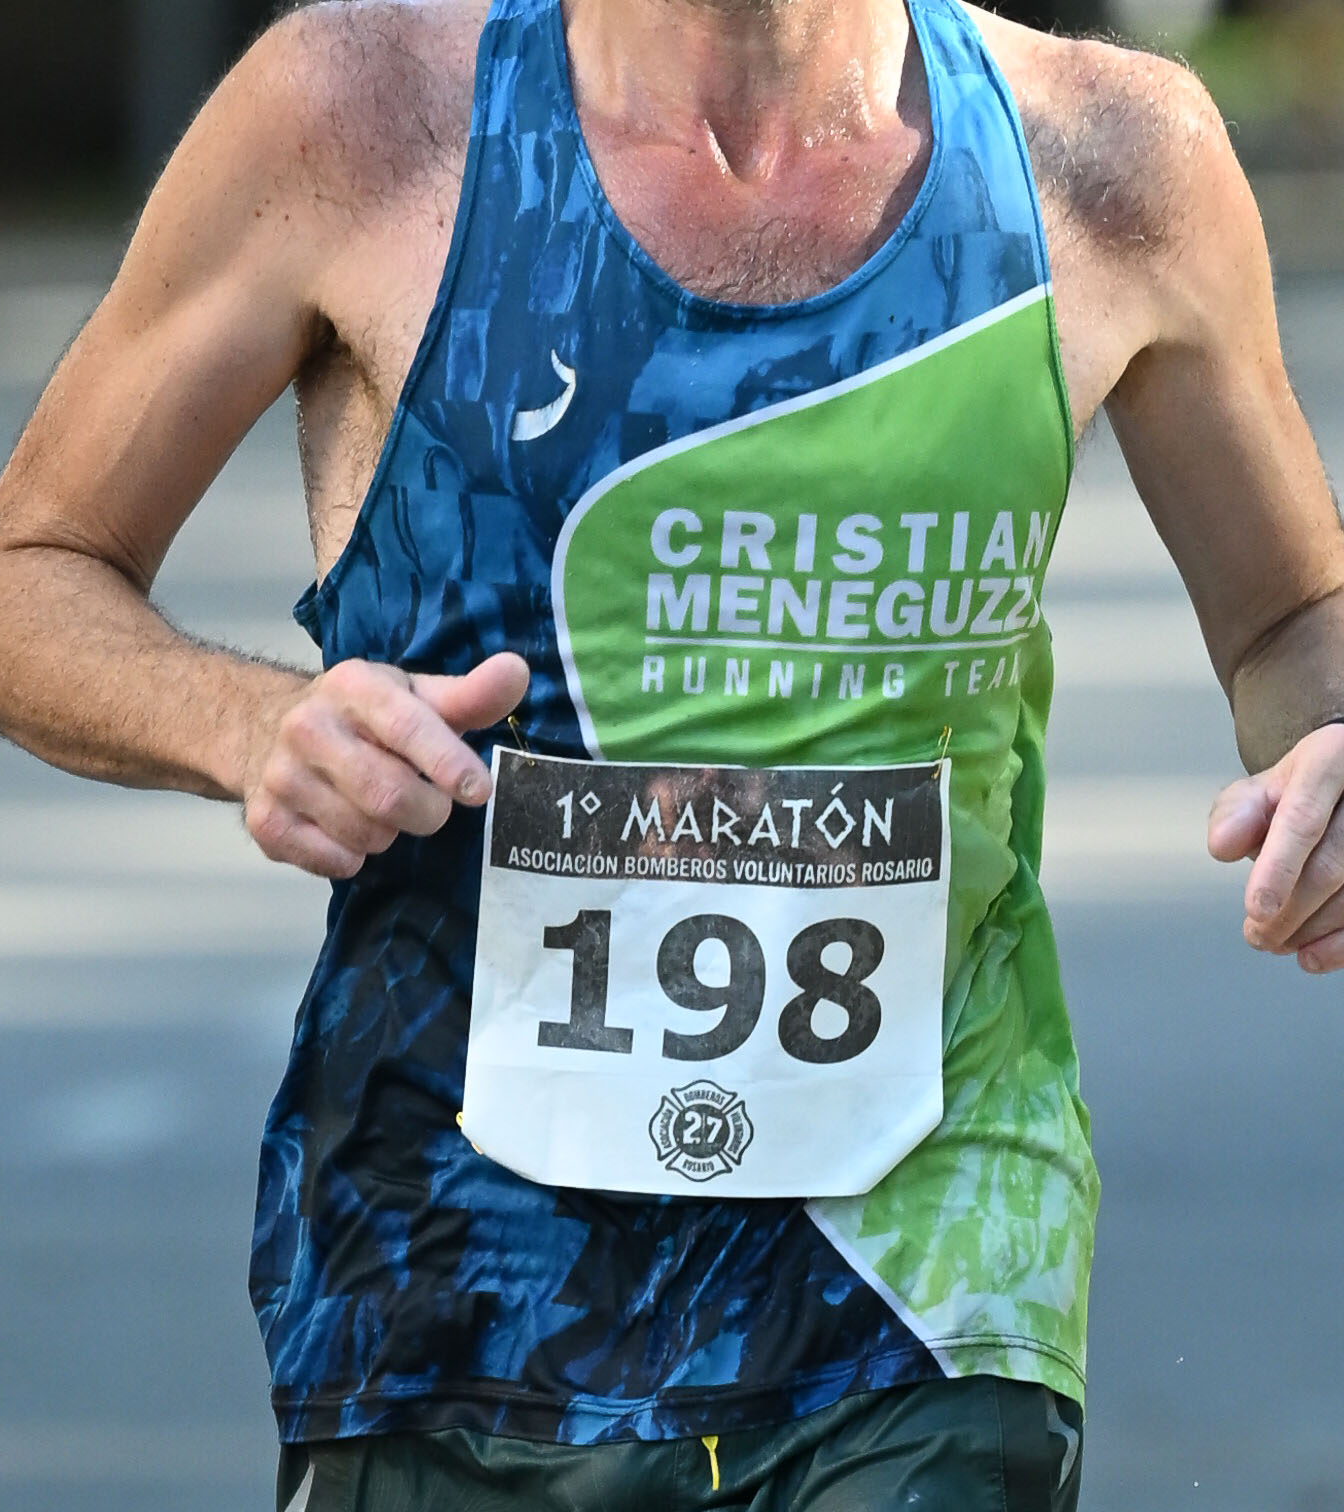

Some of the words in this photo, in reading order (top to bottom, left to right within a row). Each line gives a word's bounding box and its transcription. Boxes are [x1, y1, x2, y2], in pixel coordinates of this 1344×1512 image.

[651, 508, 1051, 574] CRISTIAN
[641, 655, 905, 699] RUNNING
[620, 782, 895, 849] MARATÓN
[508, 845, 617, 875] ASOCIACIÓN
[625, 855, 727, 880] BOMBEROS
[733, 859, 856, 884] VOLUNTARIOS
[862, 857, 934, 882] ROSARIO
[537, 909, 885, 1064] 198
[683, 1110, 723, 1144] 27
